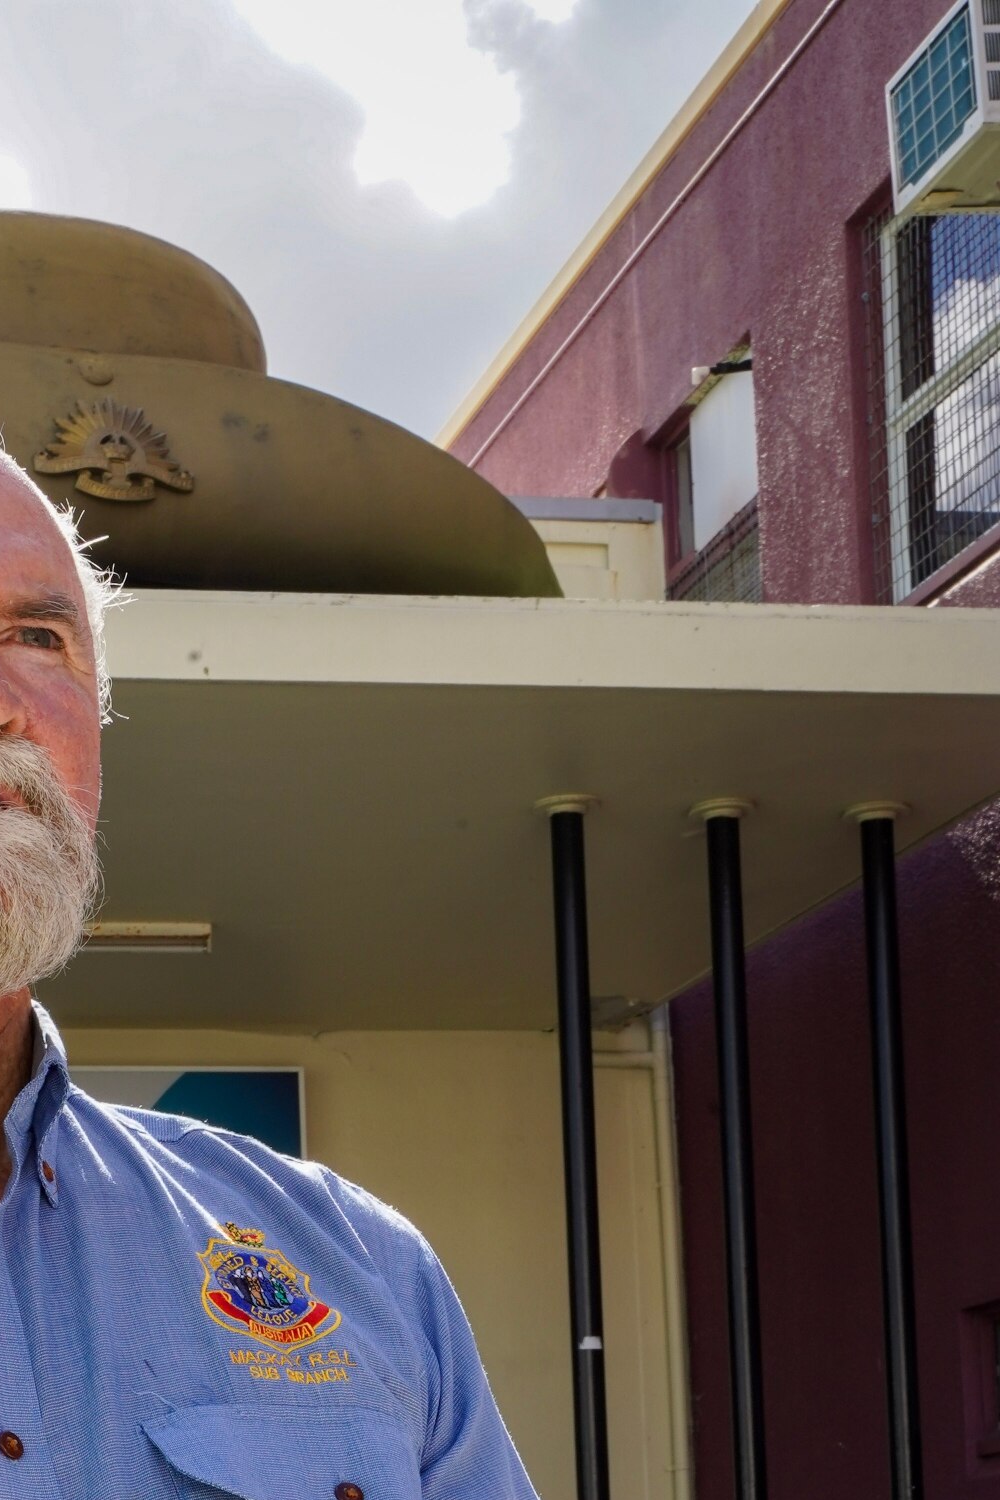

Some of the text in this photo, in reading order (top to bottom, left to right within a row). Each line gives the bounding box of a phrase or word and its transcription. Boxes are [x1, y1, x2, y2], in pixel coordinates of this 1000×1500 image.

[250, 1305, 298, 1325] LEAGUE
[252, 1323, 312, 1342] AUSTRALIA
[229, 1349, 302, 1367] MACKAY
[249, 1365, 280, 1380] SUB
